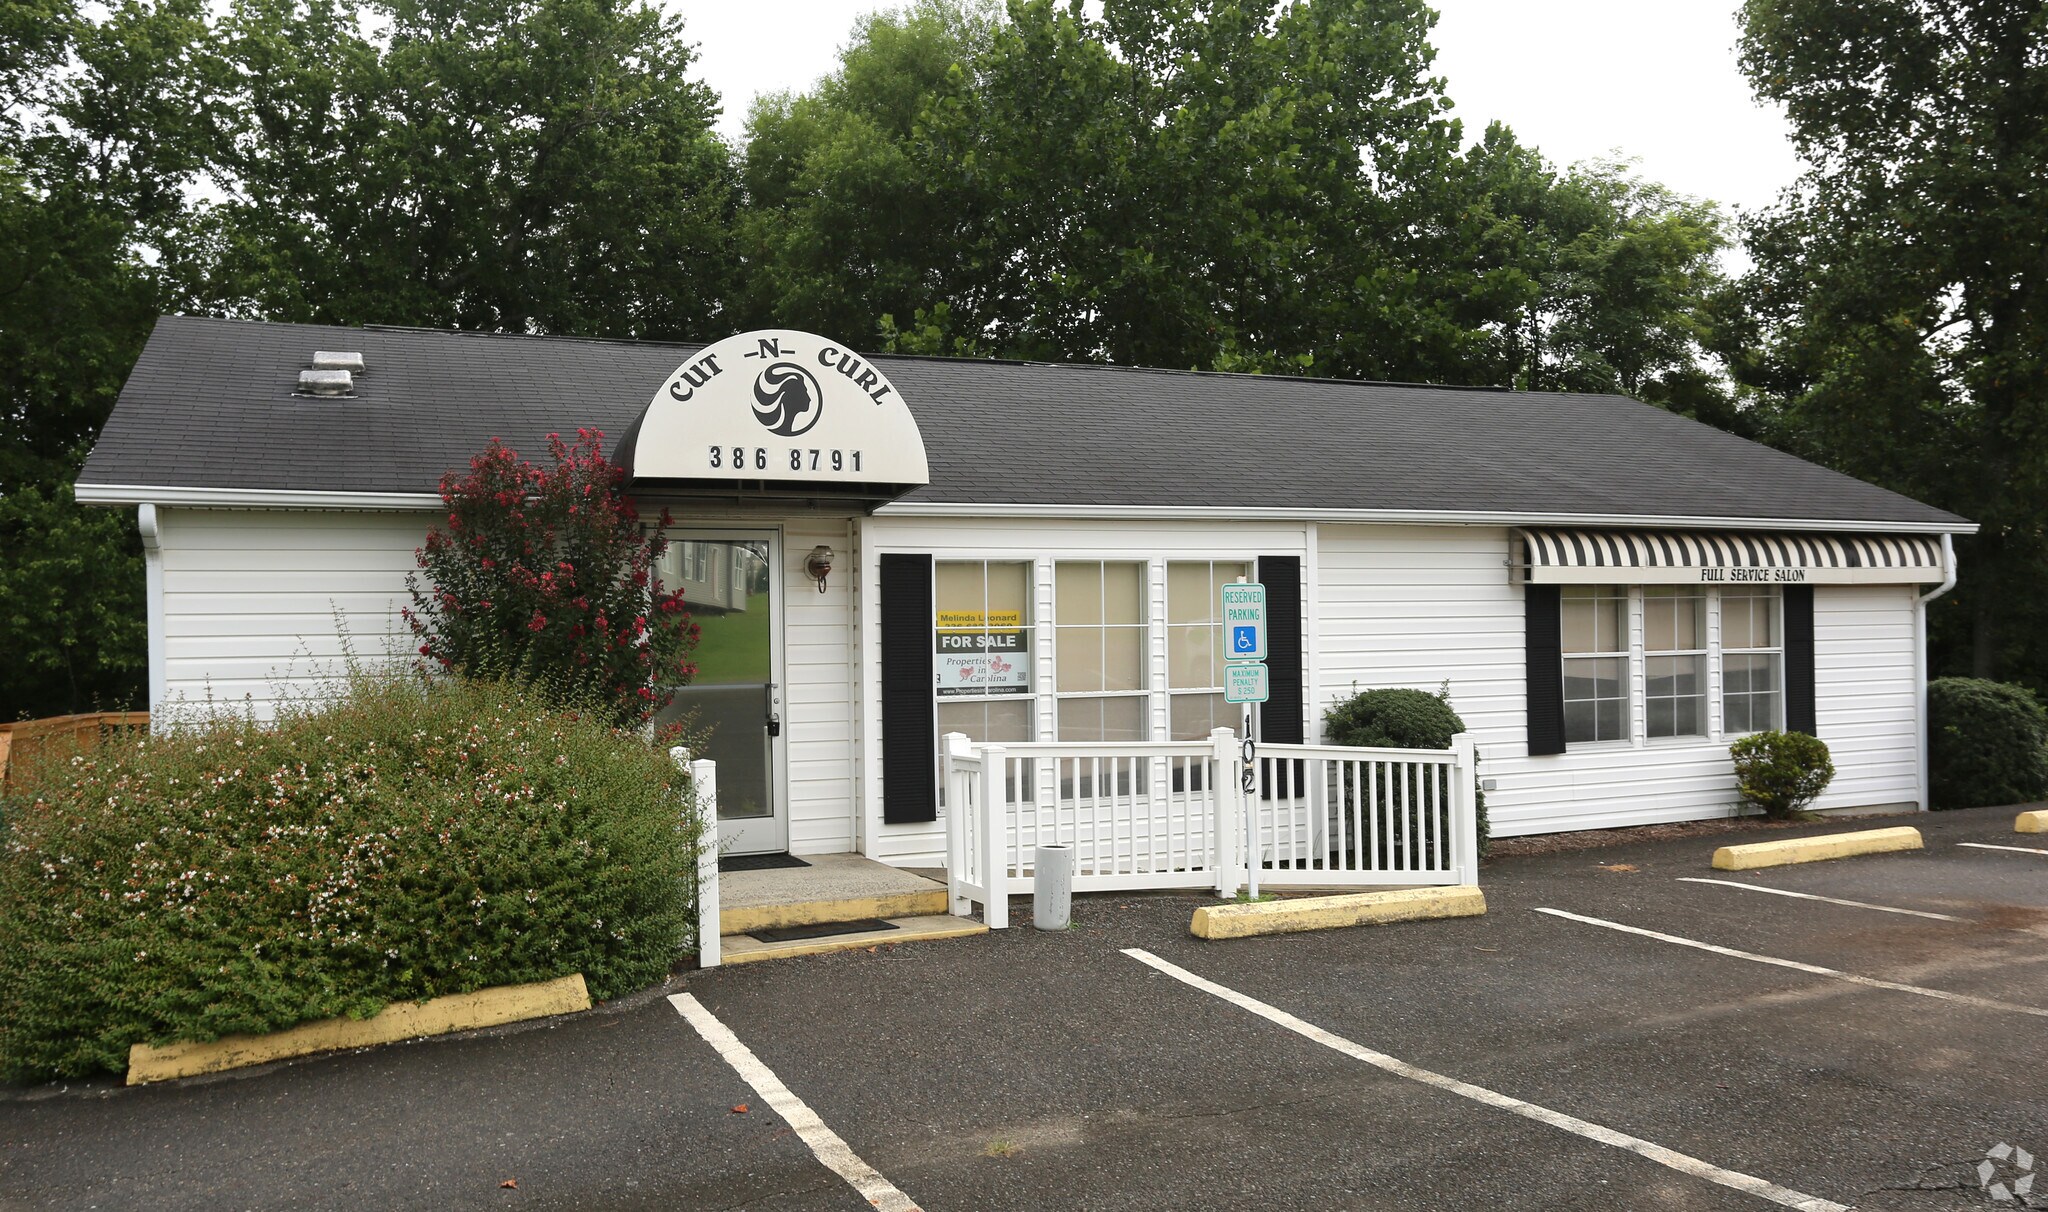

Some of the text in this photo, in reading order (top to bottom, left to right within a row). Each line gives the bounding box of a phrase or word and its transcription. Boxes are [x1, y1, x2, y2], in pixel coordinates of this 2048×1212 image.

[669, 353, 723, 402] CUT
[818, 347, 891, 406] CURL
[710, 446, 861, 472] 386 8791
[1701, 569, 1805, 582] FULL SERVICE SALON
[1225, 591, 1262, 604] RESERVED
[940, 614, 976, 622] Melinda
[1228, 608, 1260, 621] PARKING
[942, 635, 1016, 648] FOR SALE
[946, 656, 992, 667] Properties
[1232, 670, 1259, 678] MAXIMUM
[1232, 679, 1258, 687] PENALTY
